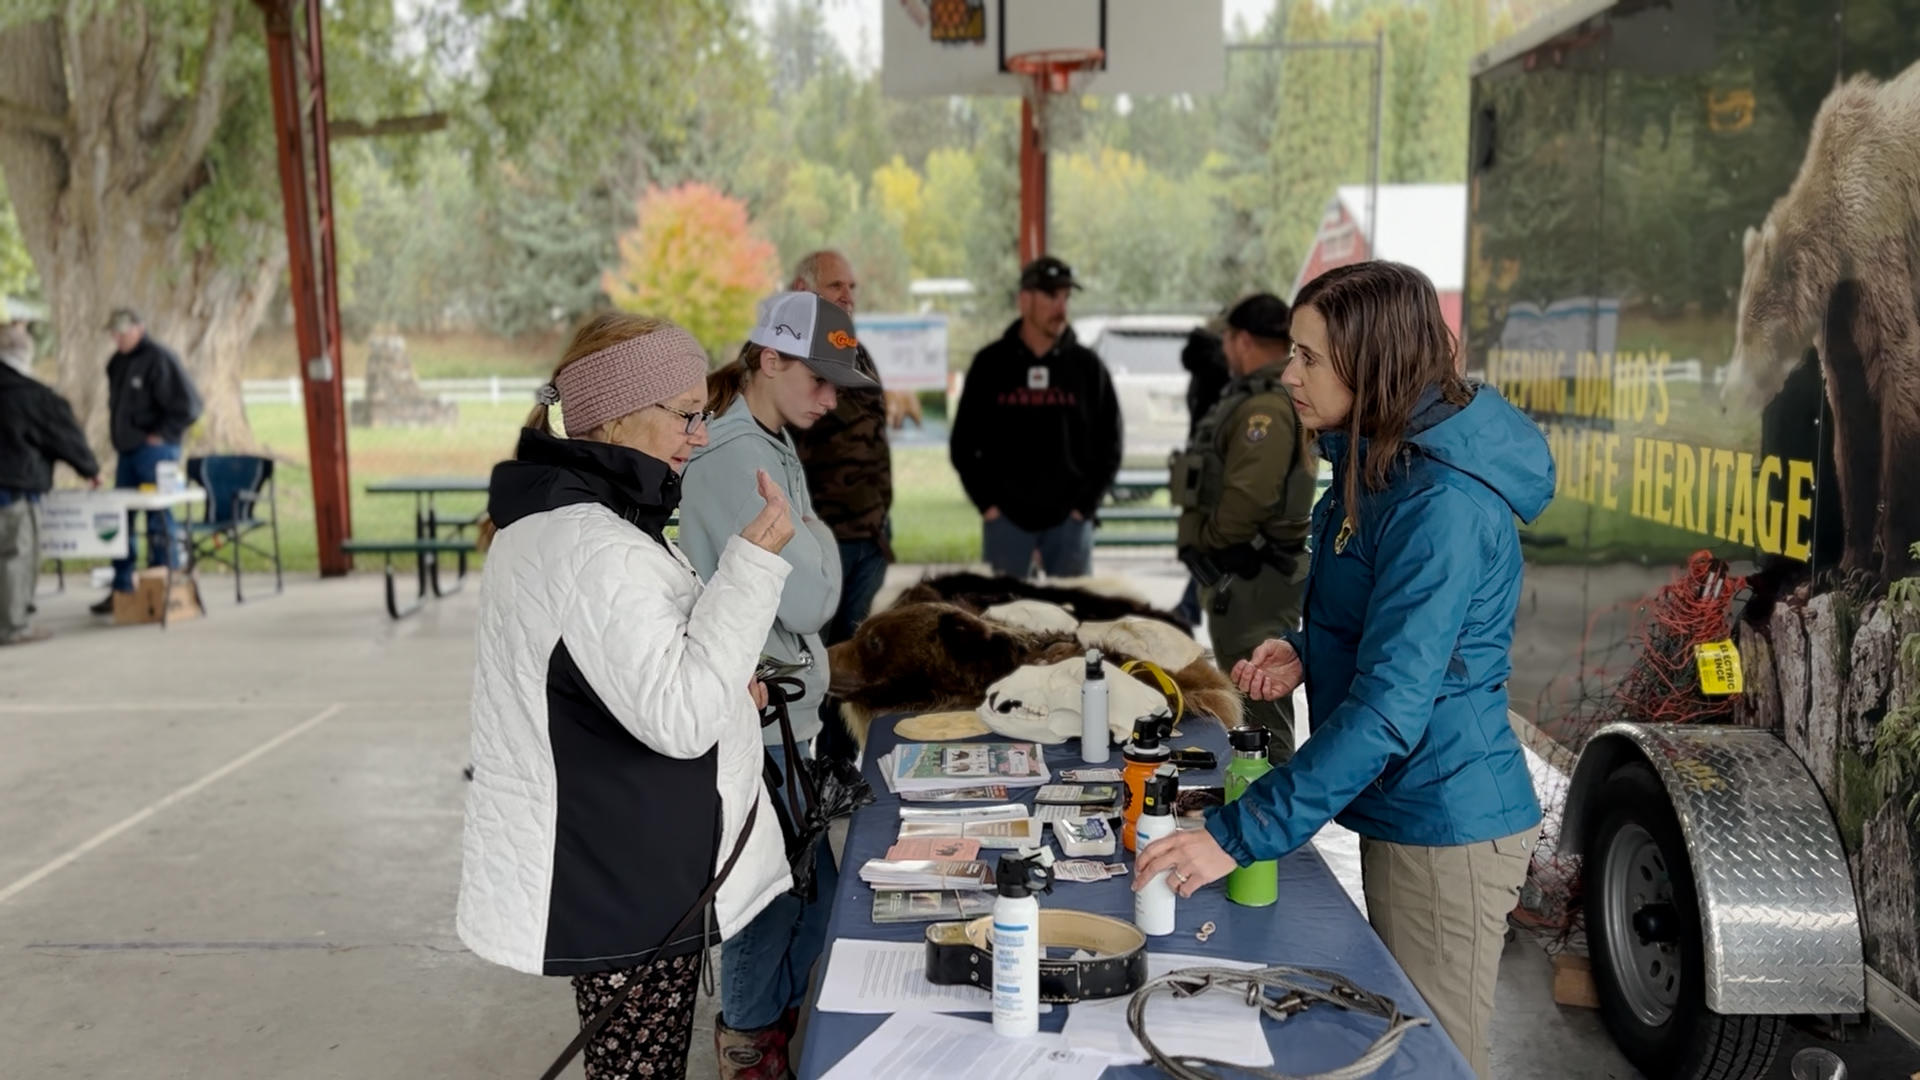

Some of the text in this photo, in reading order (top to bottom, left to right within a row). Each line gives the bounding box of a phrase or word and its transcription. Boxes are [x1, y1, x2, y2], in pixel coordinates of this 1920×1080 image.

[1575, 346, 1671, 426] IDAHO'S
[1549, 424, 1815, 562] DLIFE HERITAGE
[1719, 644, 1735, 690] ELECTRIC
